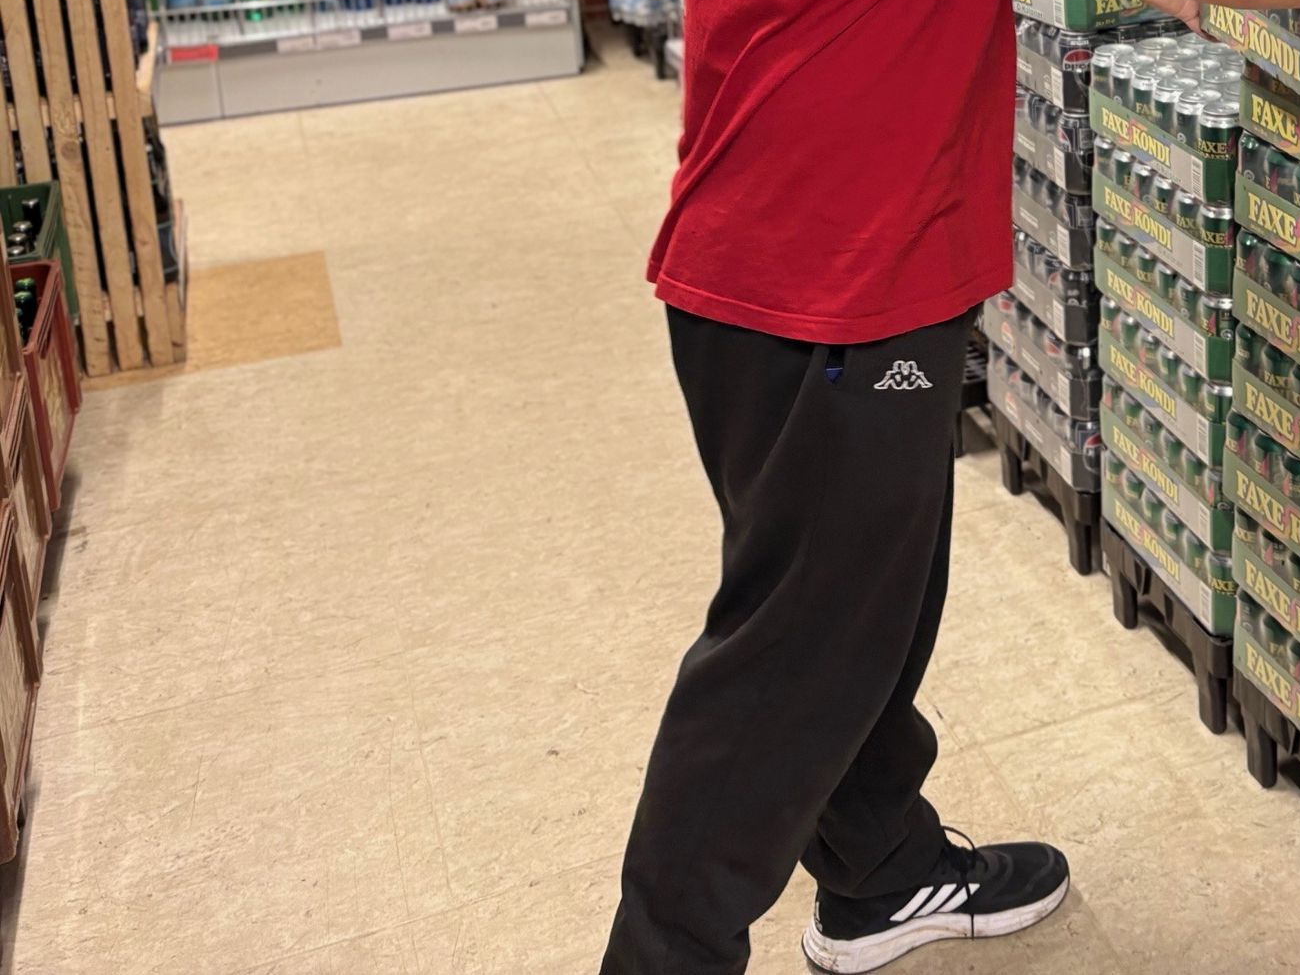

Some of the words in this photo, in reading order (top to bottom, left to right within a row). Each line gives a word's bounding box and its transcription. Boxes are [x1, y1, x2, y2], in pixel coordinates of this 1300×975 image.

[1208, 3, 1247, 49] FAXE
[1248, 20, 1300, 82] KONDI
[1102, 106, 1130, 137] FAXE
[1131, 125, 1171, 167] KONDI
[1251, 92, 1298, 144] FAXE
[1104, 185, 1133, 221] FAXE
[1133, 207, 1173, 251] KONDI
[1247, 191, 1298, 245] FAXE
[1245, 288, 1293, 346] FAXE
[1245, 381, 1295, 440] FAXE
[1236, 469, 1285, 531] FAXE
[1244, 558, 1292, 618] FAXE
[1246, 641, 1292, 706] FAXE
